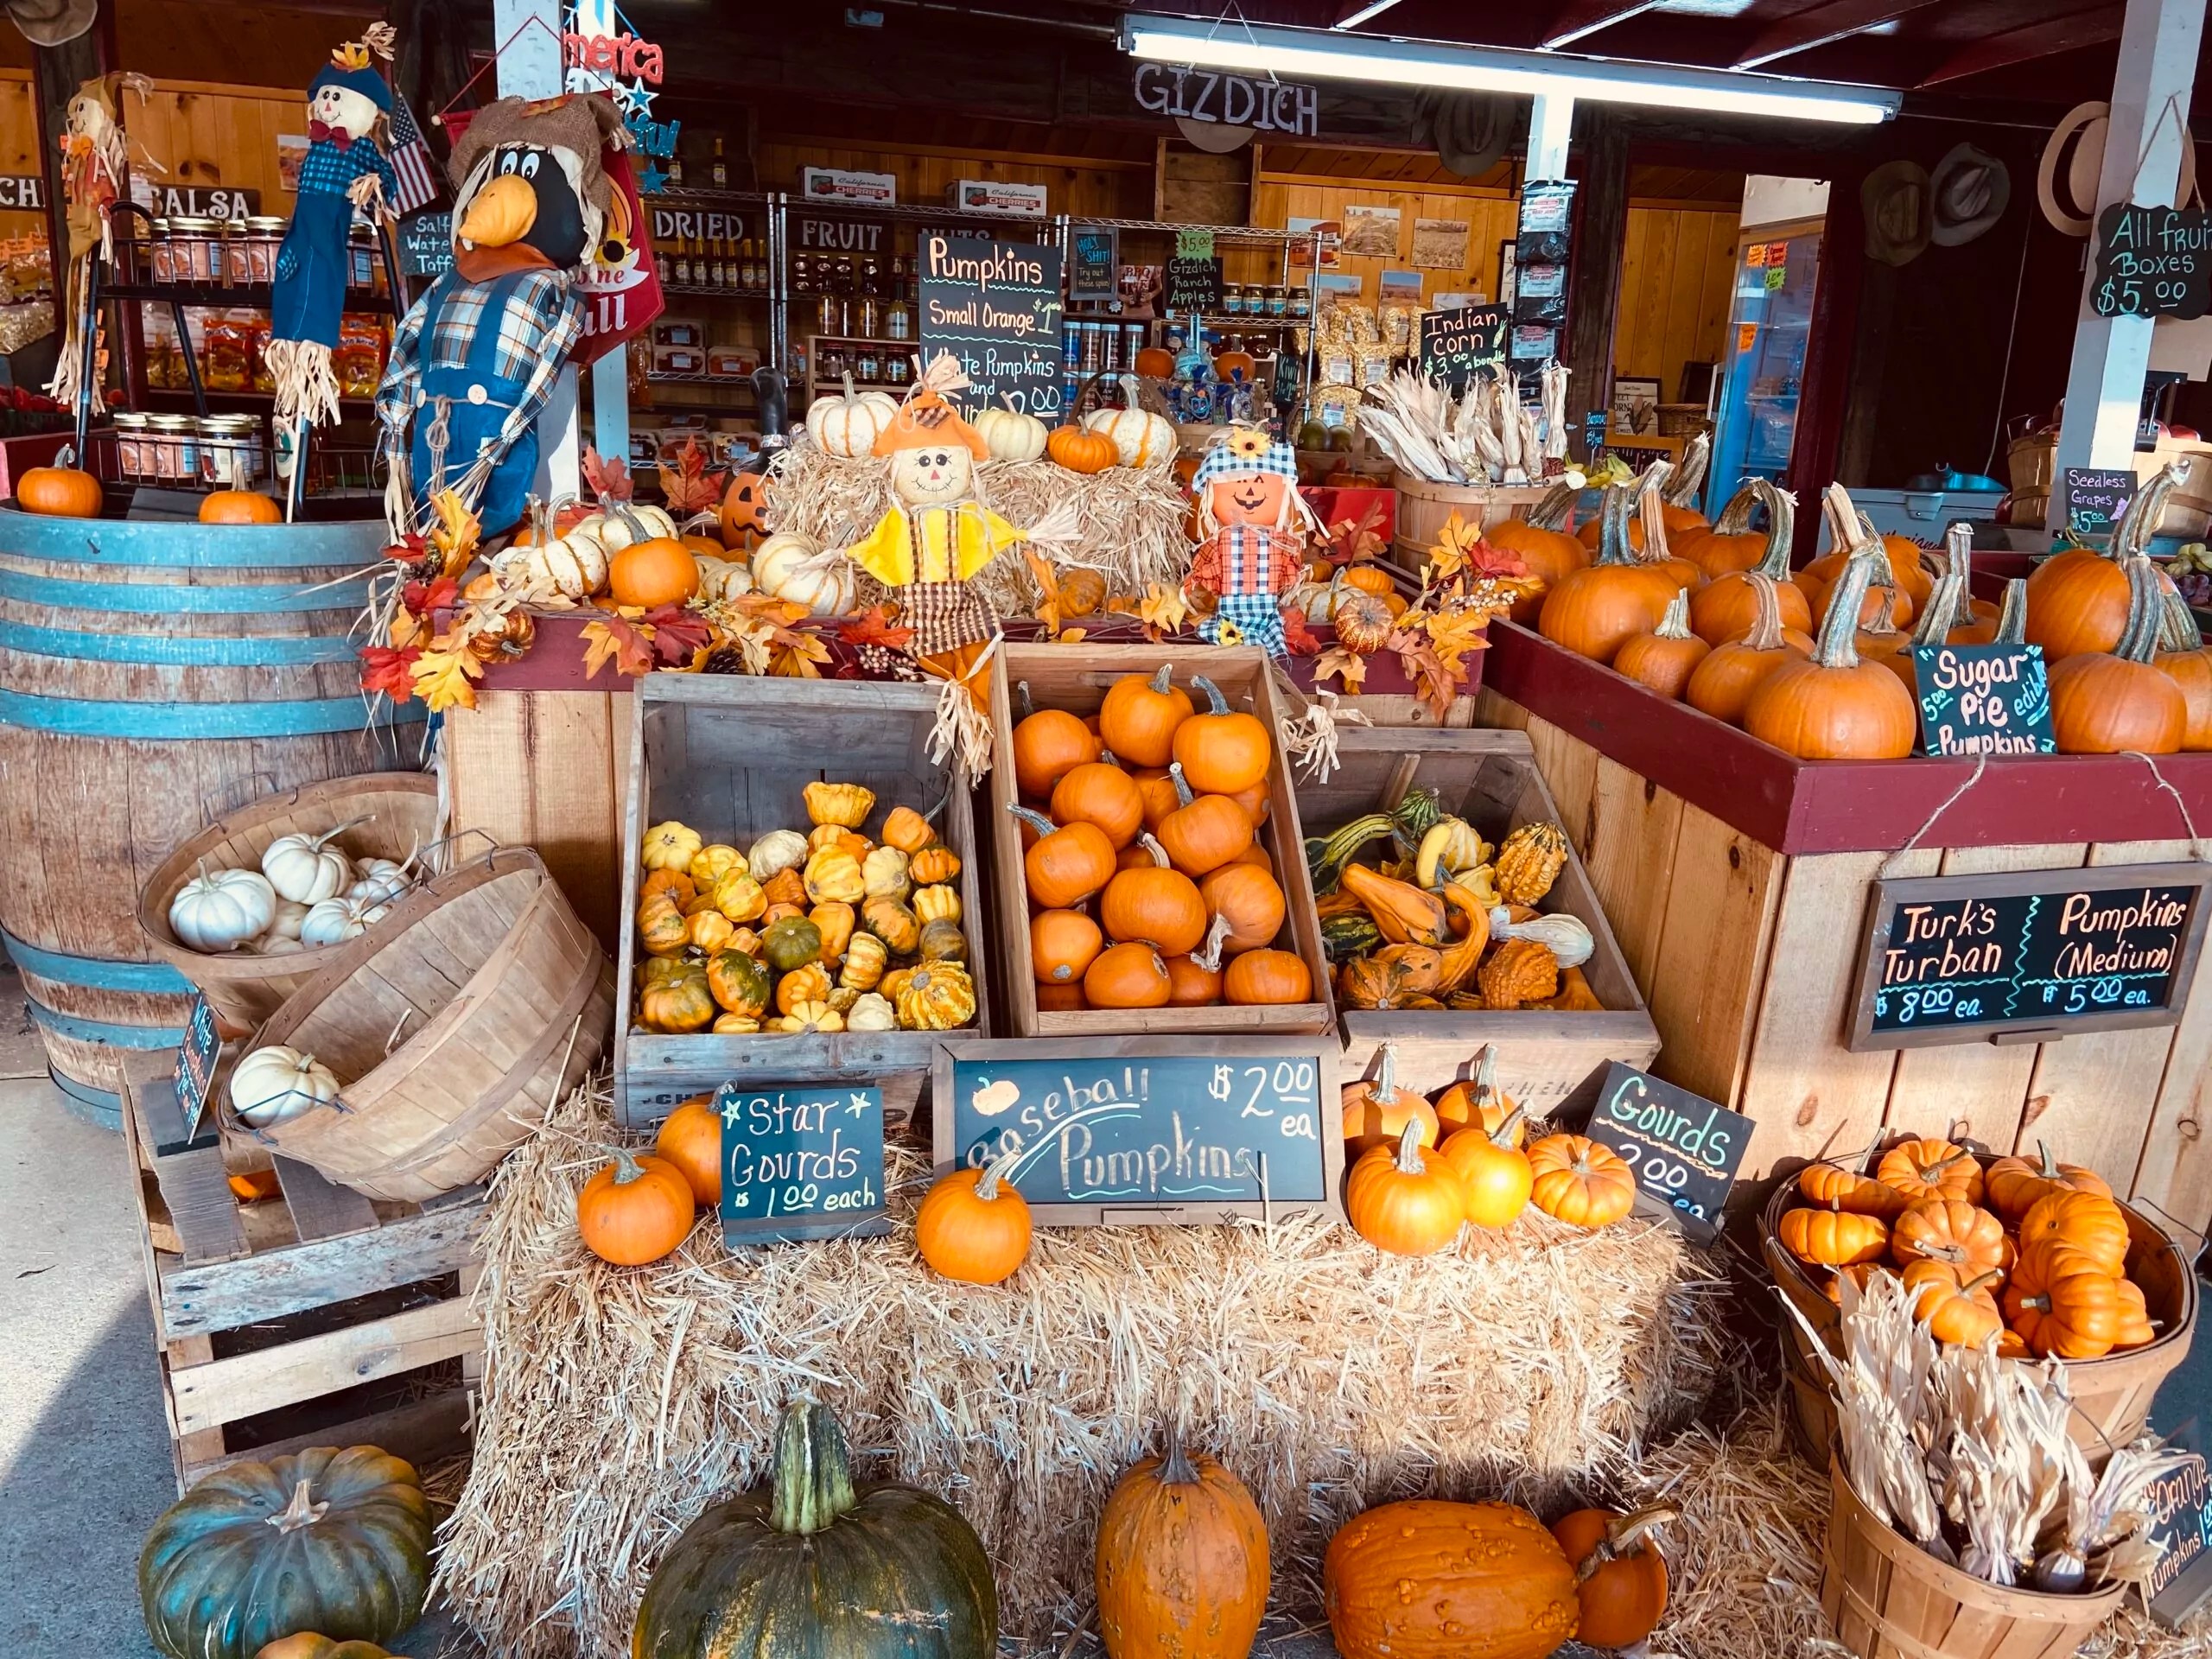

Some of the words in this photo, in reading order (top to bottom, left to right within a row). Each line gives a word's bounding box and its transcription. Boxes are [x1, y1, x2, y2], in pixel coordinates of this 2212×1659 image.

[561, 29, 664, 85] merica
[1135, 63, 1318, 137] GIZDICH
[835, 185, 886, 198] CHERRIES
[837, 176, 886, 188] California
[990, 188, 1037, 199] California
[988, 197, 1037, 207] CHERRIES
[416, 216, 450, 232] Salt
[654, 210, 744, 240] DRIED
[801, 219, 883, 251] FRUIT
[2109, 211, 2151, 249] All
[407, 234, 449, 251] Wate
[1077, 235, 1099, 255] HOLY
[1180, 236, 1211, 252] $5.00
[929, 237, 1043, 293] Pumpkins
[1077, 267, 1090, 280] Try
[1169, 258, 1217, 275] Gizdich
[2110, 251, 2195, 276] Boxes
[1169, 289, 1216, 305] Apples
[1171, 275, 1212, 289] Ranch
[2097, 276, 2187, 316] $5.00
[929, 299, 977, 327] Small
[982, 302, 1035, 337] Orange
[1425, 308, 1497, 338] Indian
[985, 348, 1055, 384] Pumpkins
[1279, 356, 1299, 380] Kiwi
[1465, 361, 1472, 370] a
[1473, 349, 1506, 368] bundle
[969, 379, 995, 396] and
[2069, 469, 2126, 488] Seedless
[2071, 489, 2113, 509] Grapes
[1933, 650, 2029, 698] Sugar
[1960, 691, 2008, 727] Pie
[1938, 724, 2037, 755] Pumpkins
[1904, 899, 1997, 944] Turk's
[2060, 889, 2187, 943] Pumpkins
[1885, 939, 2002, 984] Turban
[2054, 933, 2177, 980] (Medium)
[194, 996, 213, 1055] White
[749, 1093, 840, 1136] Star
[967, 1066, 1150, 1171] Baseball
[1281, 1112, 1318, 1141] ea
[1611, 1076, 1731, 1166] Gourds
[731, 1128, 861, 1187] Gourds
[1060, 1110, 1254, 1193] Pumpkins
[823, 1176, 876, 1211] each
[2155, 1457, 2209, 1525] Orange
